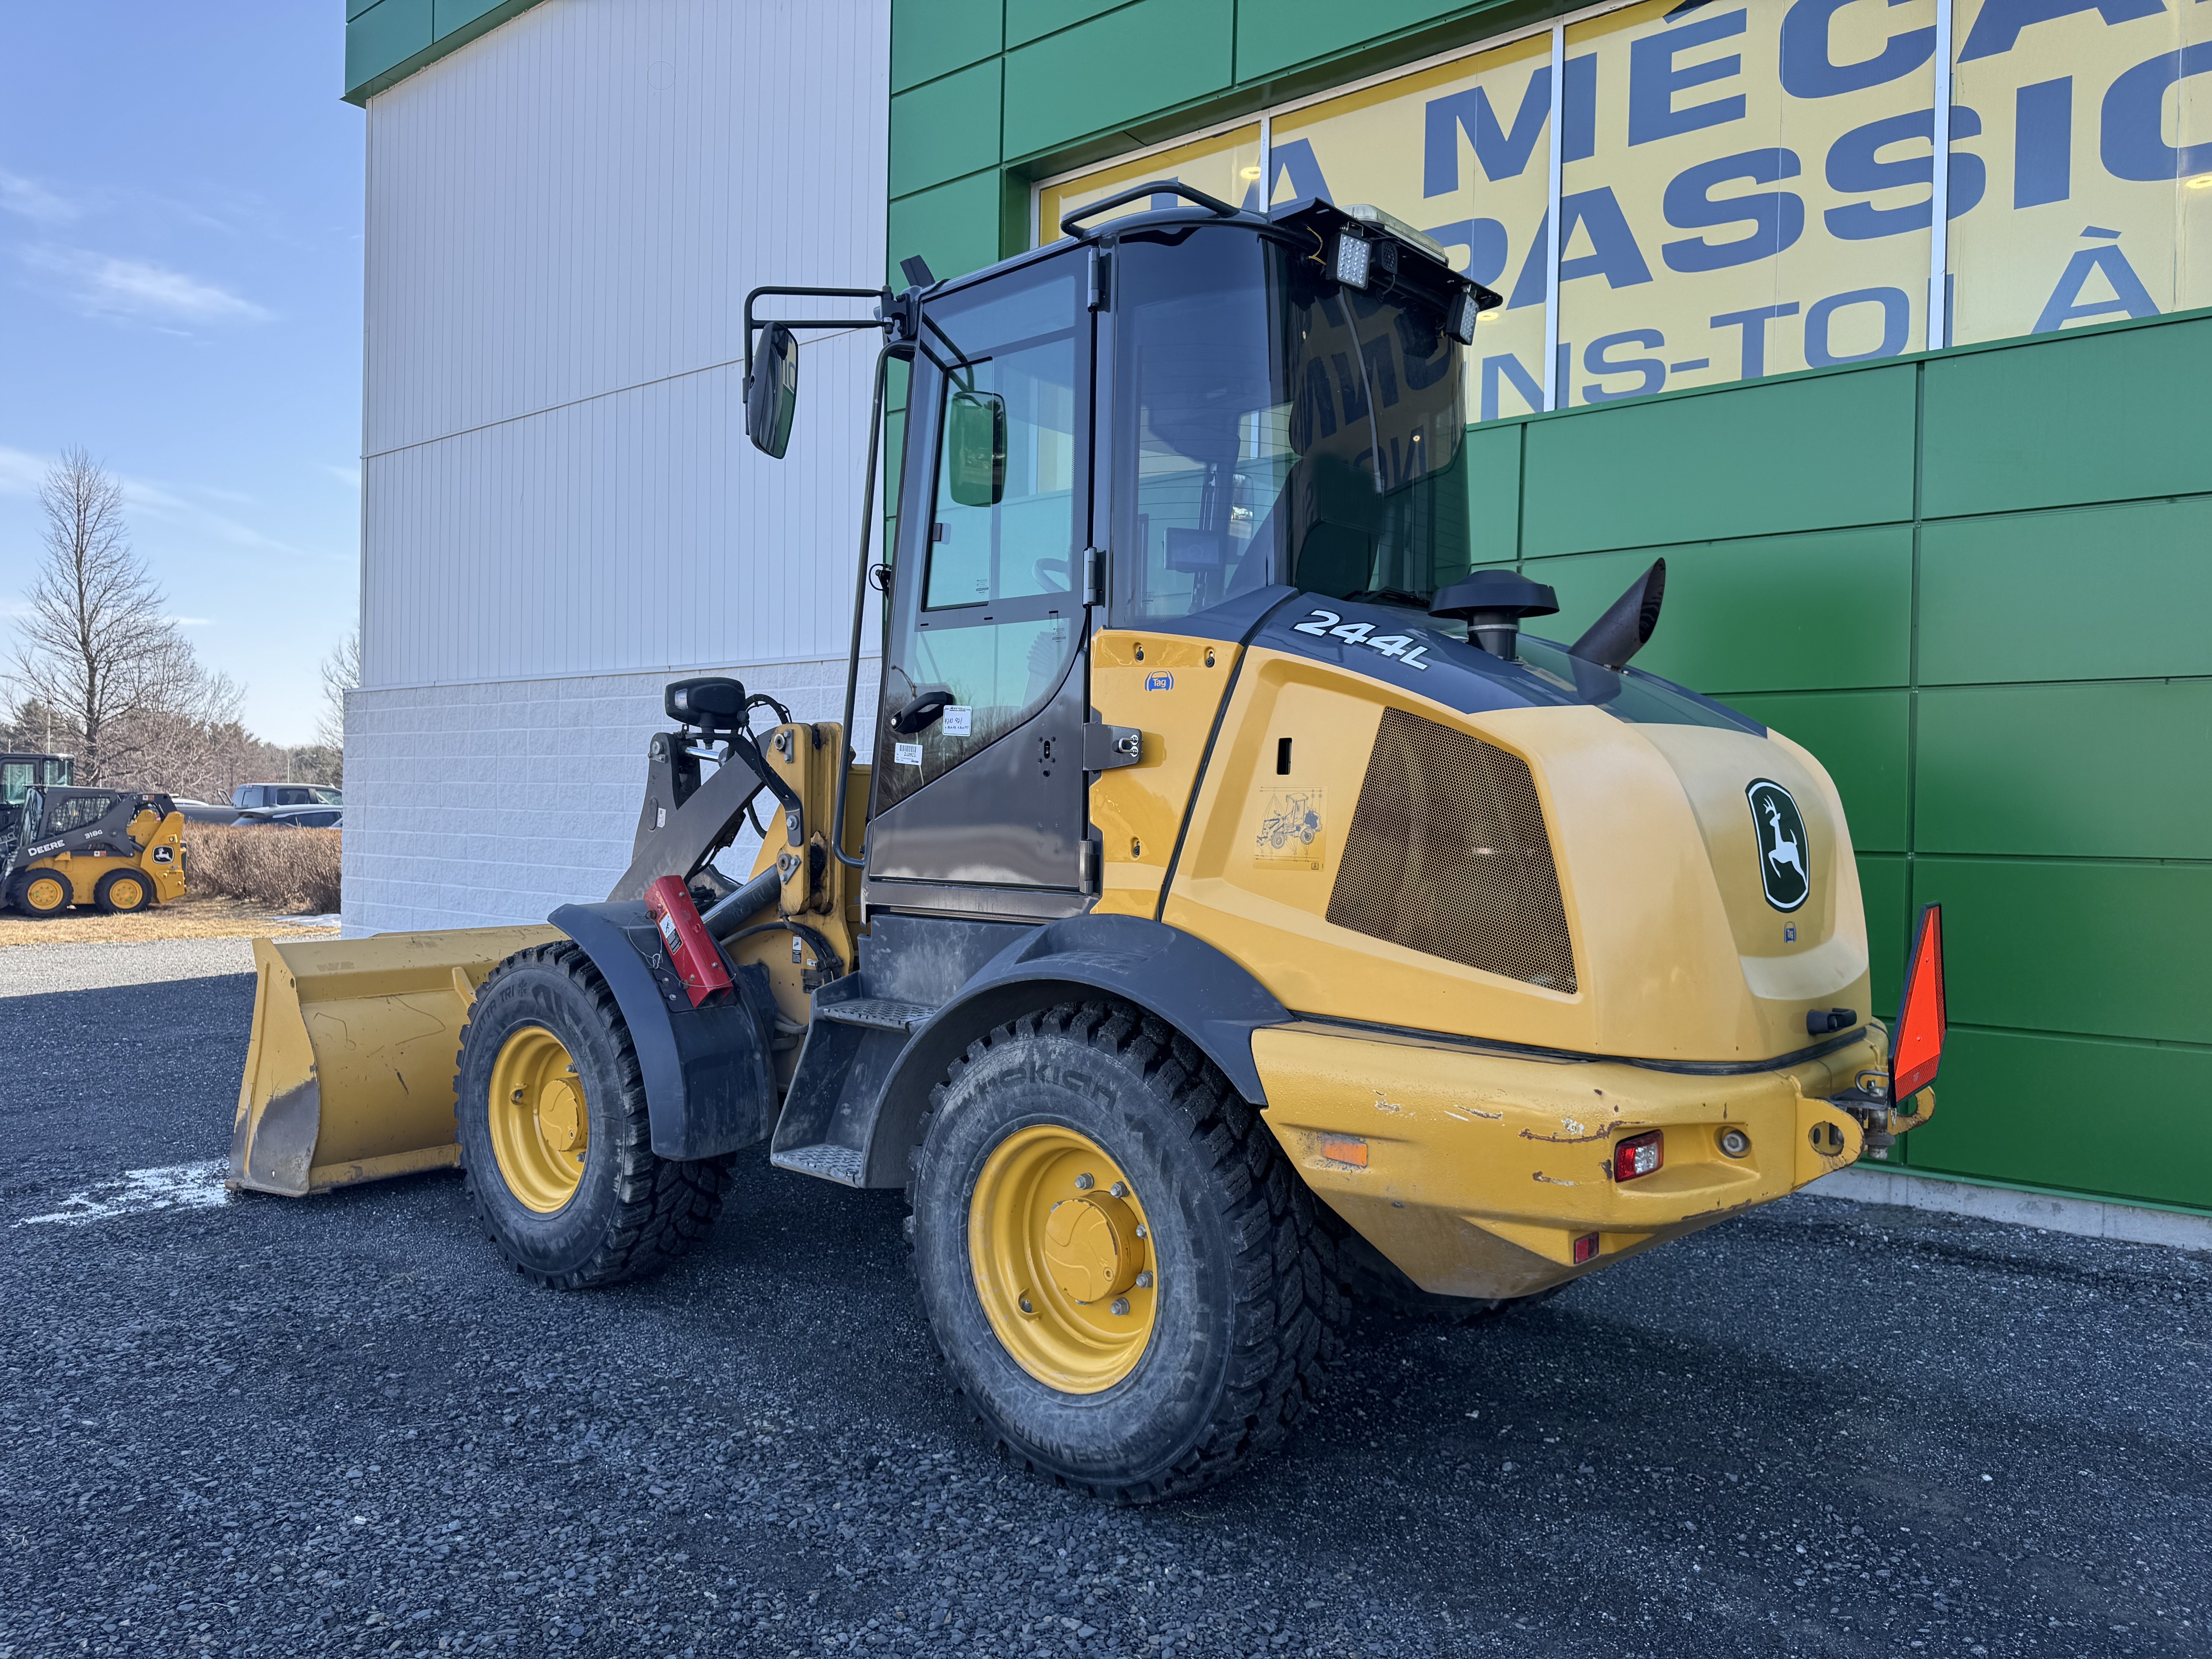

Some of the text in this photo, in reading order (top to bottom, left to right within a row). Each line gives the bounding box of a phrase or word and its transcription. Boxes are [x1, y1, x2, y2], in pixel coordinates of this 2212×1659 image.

[2030, 226, 2162, 335] À
[1294, 610, 1428, 670] 244L
[1152, 678, 1166, 688] Tag
[27, 839, 65, 857] DEERE
